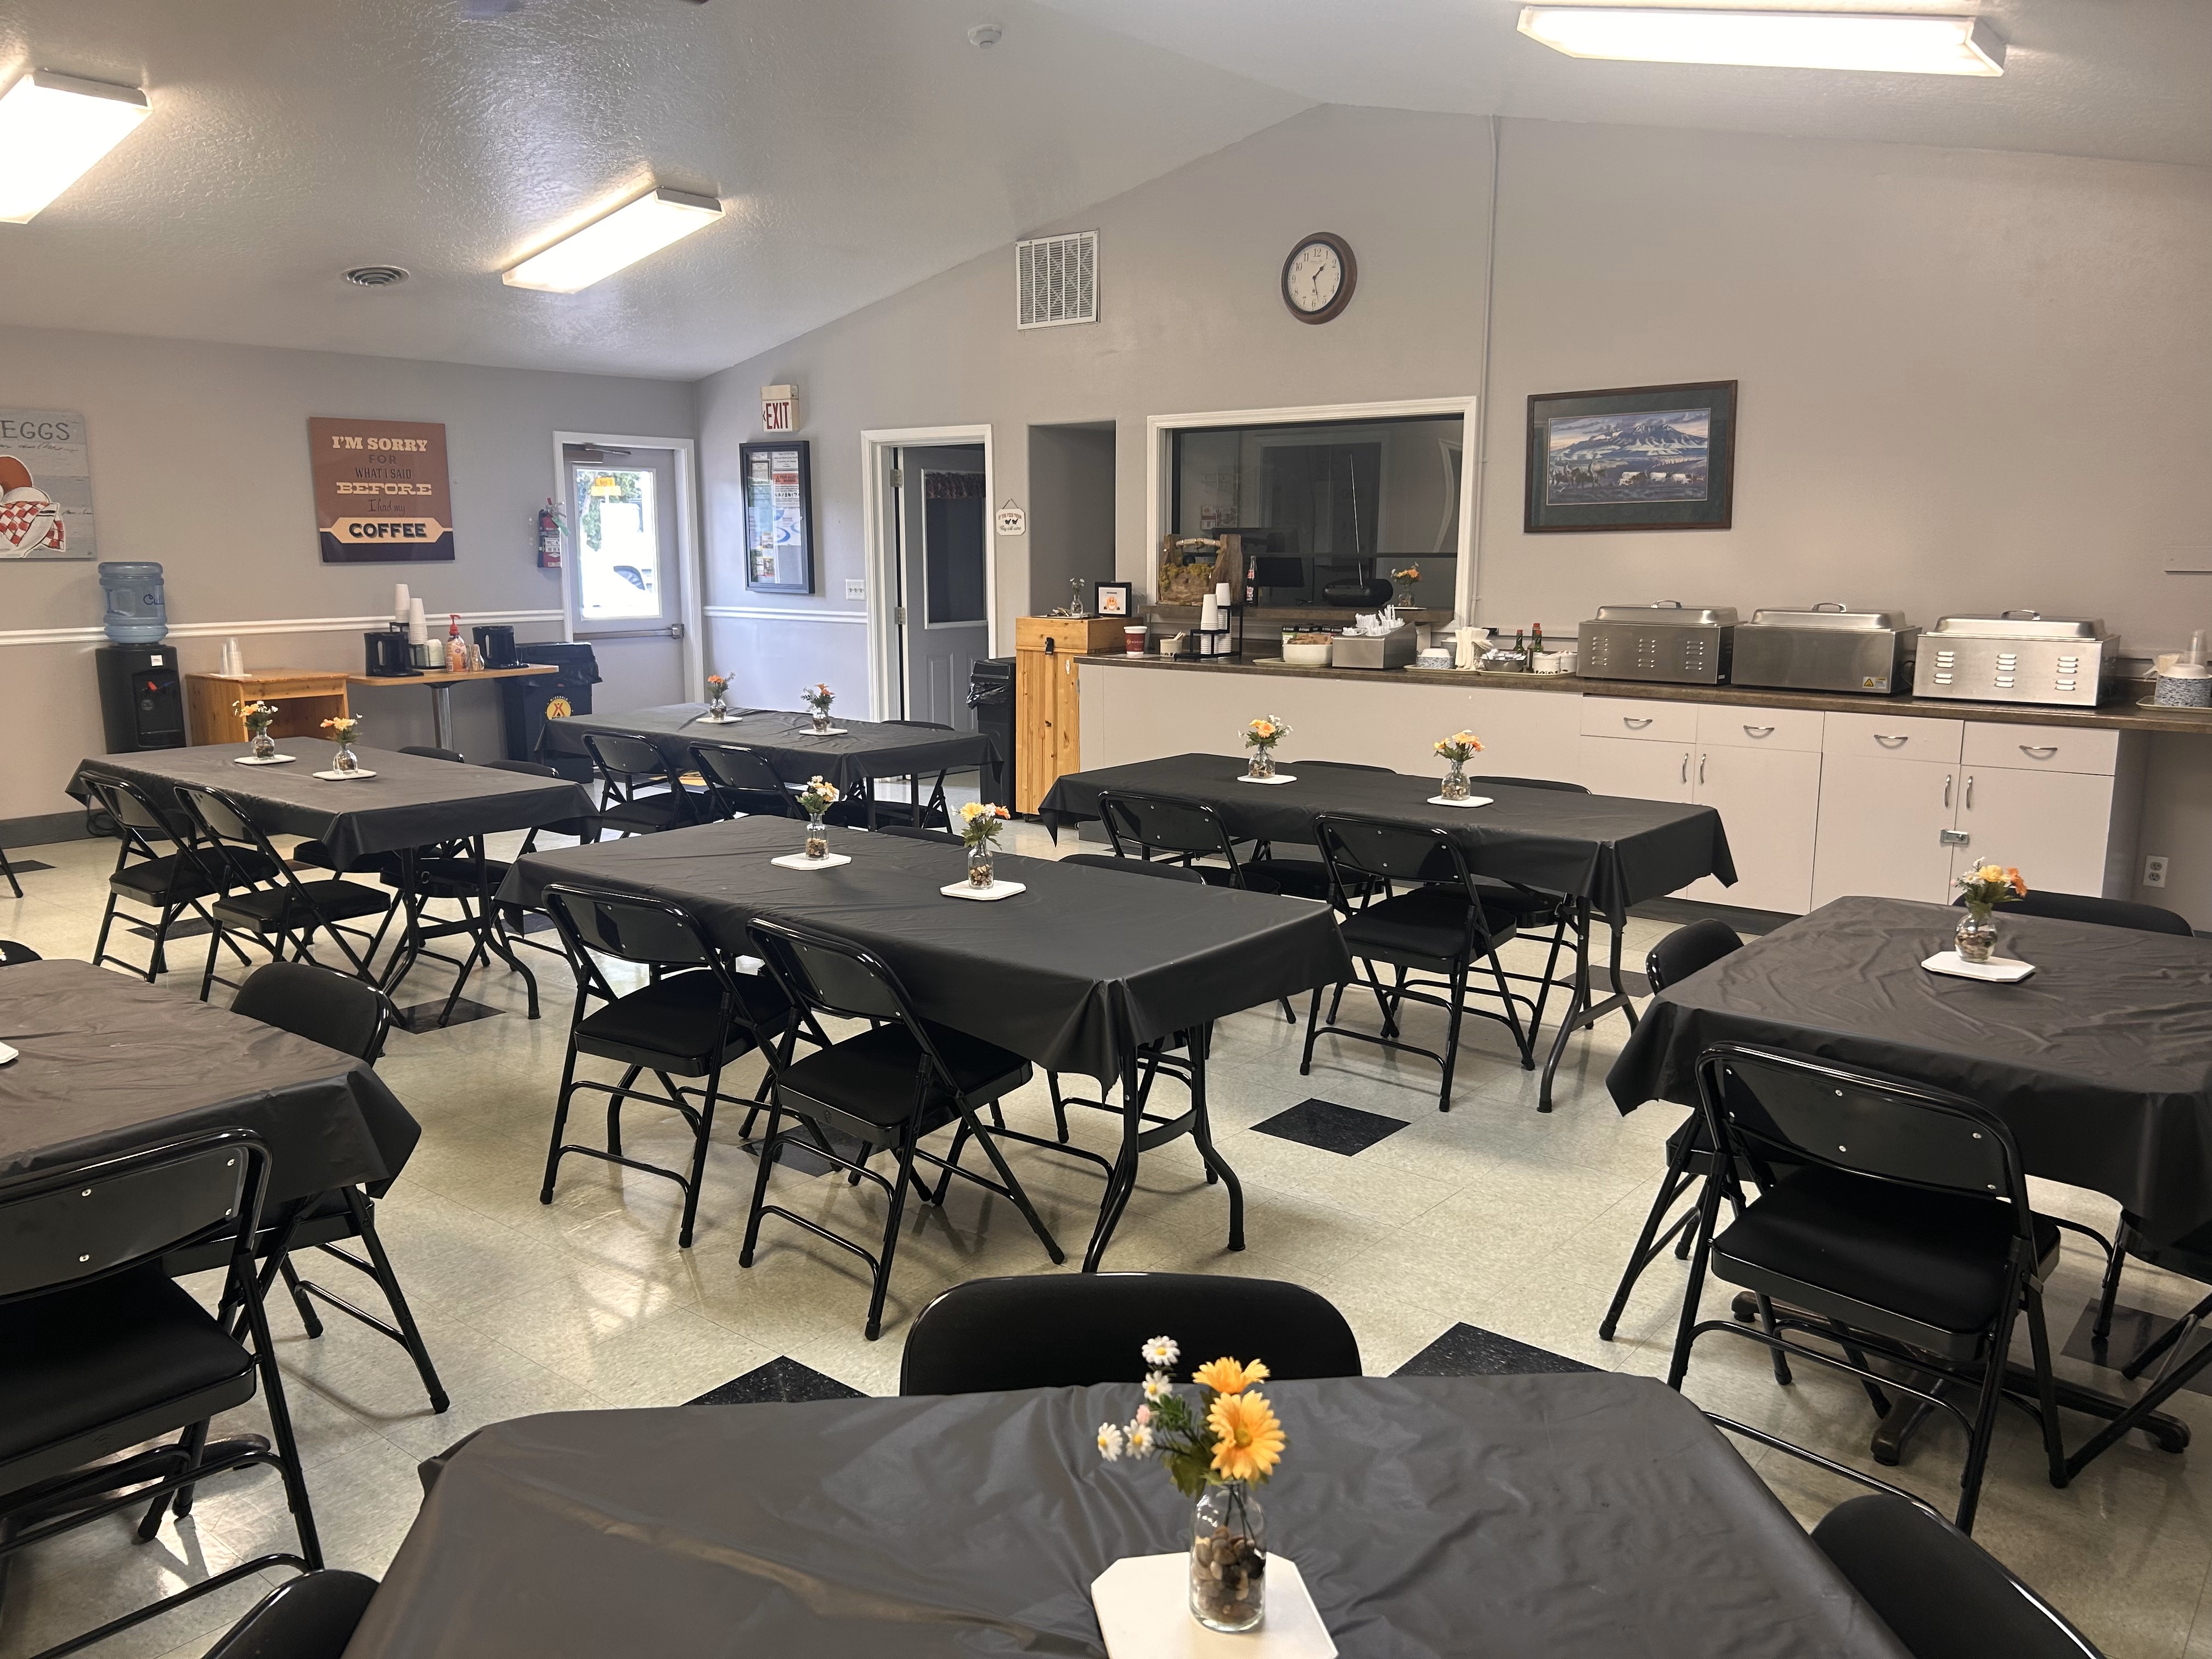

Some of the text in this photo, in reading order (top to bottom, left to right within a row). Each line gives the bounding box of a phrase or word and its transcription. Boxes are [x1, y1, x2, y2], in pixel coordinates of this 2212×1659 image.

[1304, 252, 1309, 262] 11
[1313, 248, 1322, 257] 12
[1325, 250, 1328, 259] 1
[1295, 262, 1302, 271] 10
[1331, 259, 1337, 268] 2
[1291, 275, 1296, 284] 9
[1334, 273, 1339, 281] 3
[1294, 287, 1299, 297] 8
[1330, 285, 1335, 294] 4
[1302, 296, 1307, 305] 7
[1311, 298, 1316, 308] 6
[1322, 295, 1327, 304] 5
[765, 402, 789, 429] EXIT
[0, 420, 70, 441] EGGS
[331, 436, 428, 452] I'M SORRY
[369, 454, 397, 464] FOR
[356, 467, 411, 479] WHAT I SAID
[336, 482, 432, 495] BEFORE
[368, 499, 405, 517] I had my
[348, 523, 427, 538] COFFEE
